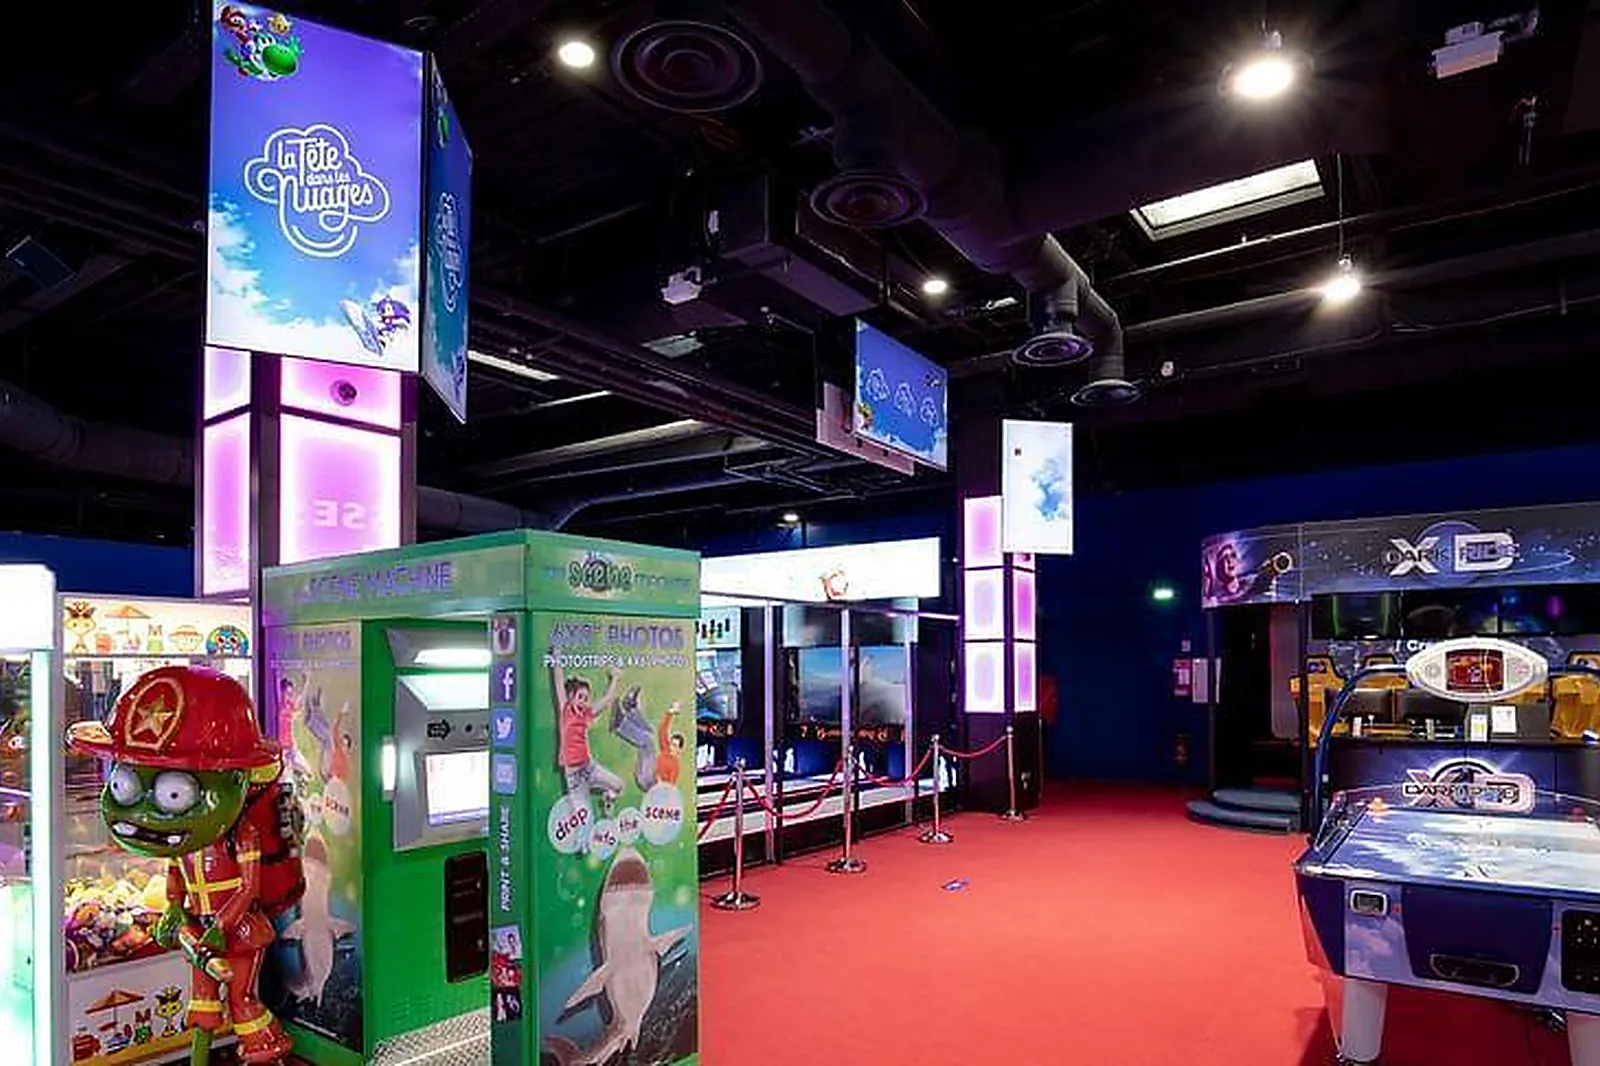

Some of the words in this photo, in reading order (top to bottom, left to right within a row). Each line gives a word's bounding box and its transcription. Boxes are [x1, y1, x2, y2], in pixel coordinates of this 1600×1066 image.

[278, 141, 297, 170] la
[286, 138, 343, 186] Tête
[279, 174, 374, 213] Nuages
[605, 624, 688, 649] PHOTOS
[555, 807, 589, 841] drop
